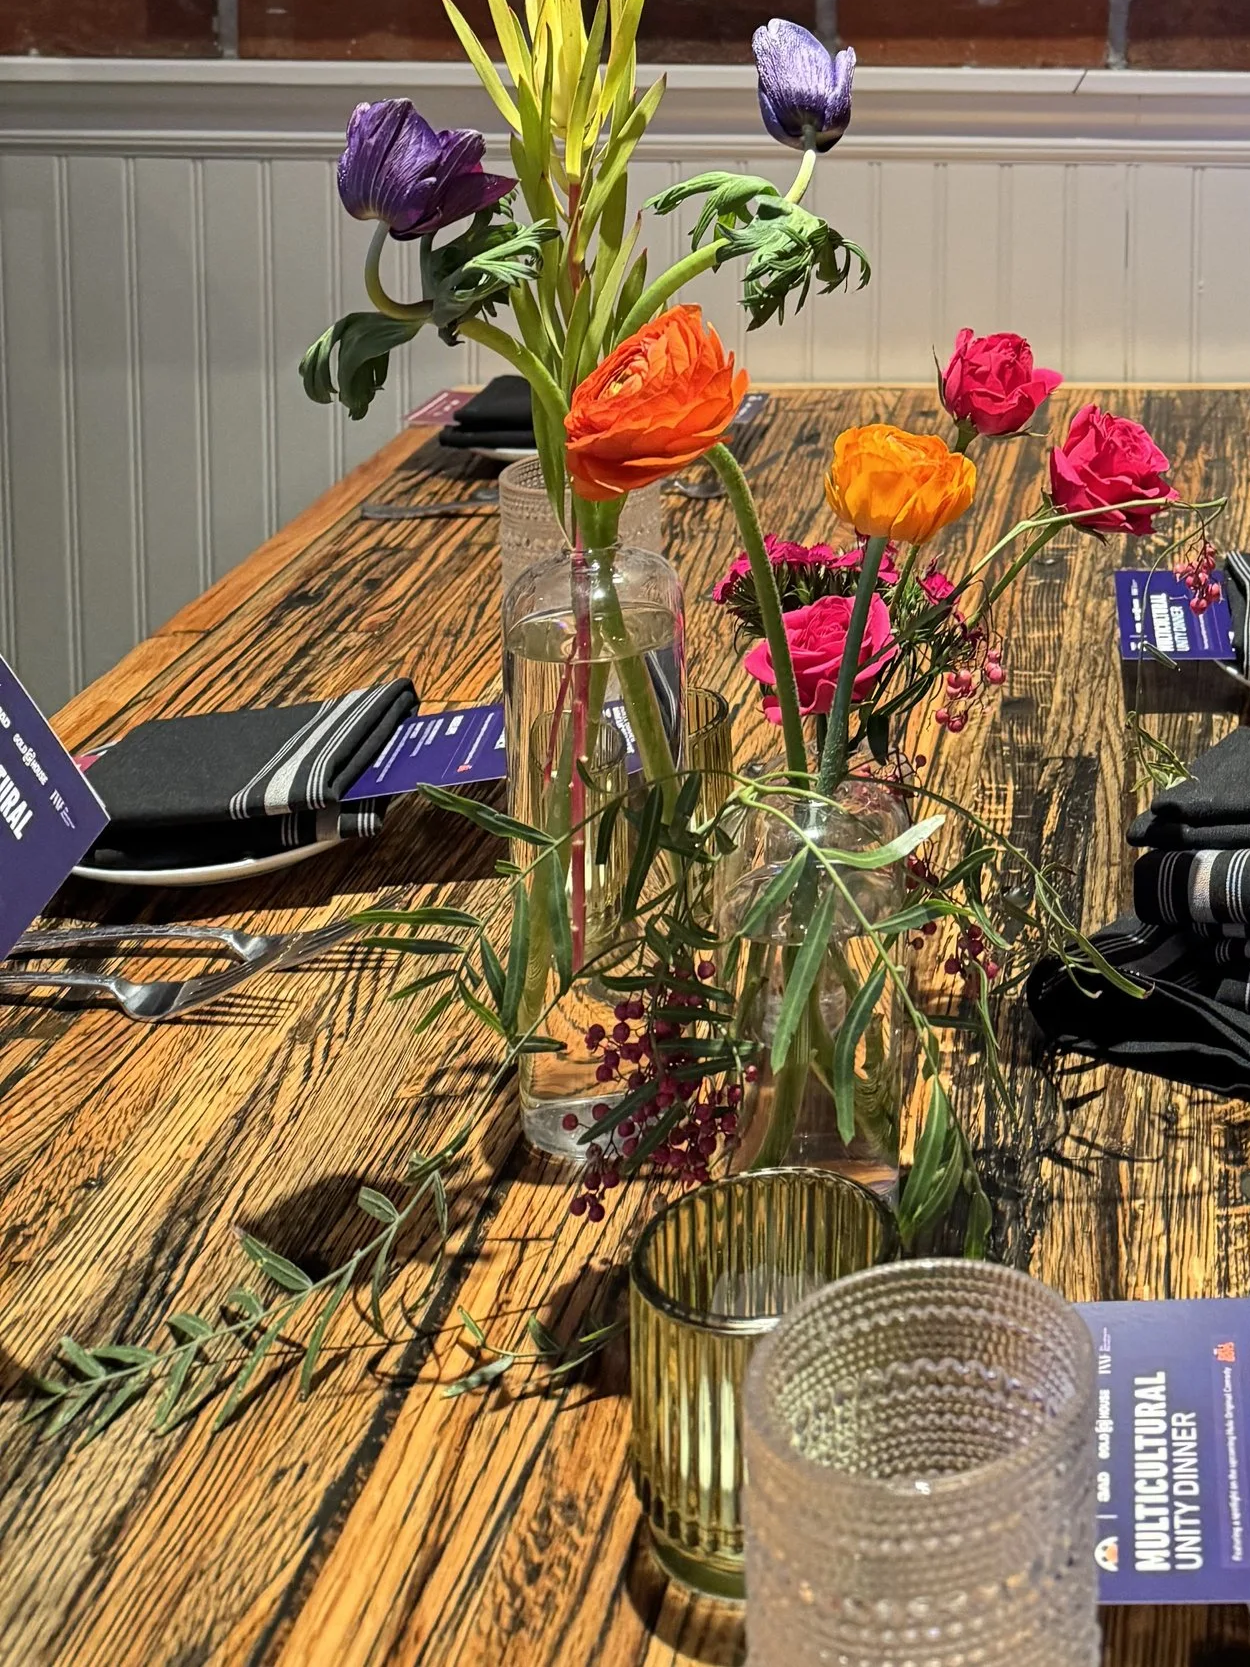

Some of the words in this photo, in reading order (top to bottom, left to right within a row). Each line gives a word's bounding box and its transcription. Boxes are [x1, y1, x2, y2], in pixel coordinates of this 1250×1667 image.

[1150, 593, 1175, 651] MULTICULTURAL
[1170, 606, 1187, 632] DINNER
[1174, 633, 1190, 652] UNITY
[1222, 1367, 1233, 1392] Comedy
[1098, 1389, 1111, 1420] HOUSE
[1224, 1393, 1236, 1419] Original
[1171, 1411, 1200, 1497] DINNER
[1226, 1436, 1239, 1468] upcoming
[1133, 1370, 1172, 1572] MULTICULTURAL
[1229, 1490, 1241, 1519] spotlight
[1174, 1501, 1204, 1571] UNITY
[1231, 1526, 1244, 1562] Featuring
